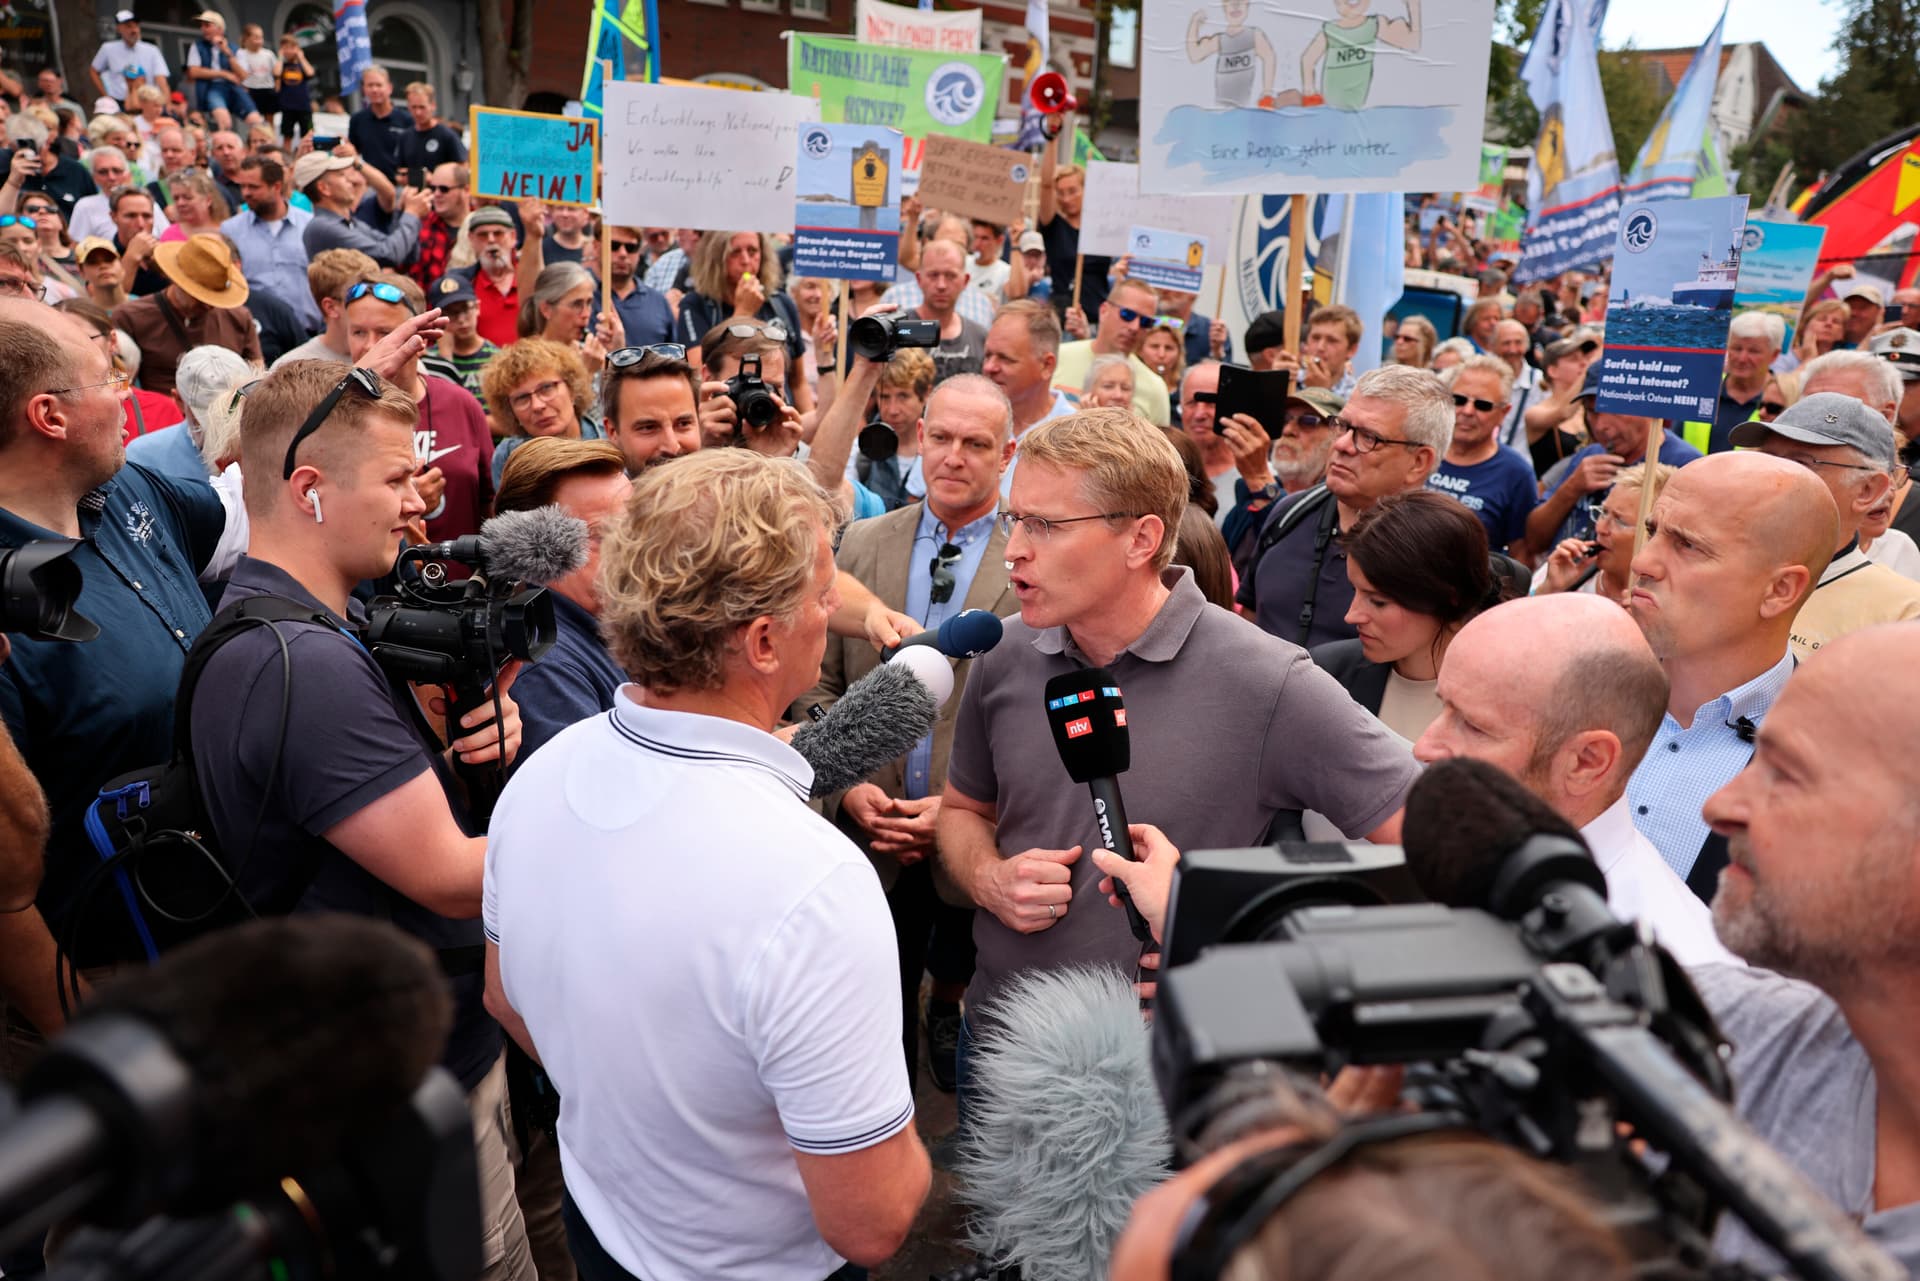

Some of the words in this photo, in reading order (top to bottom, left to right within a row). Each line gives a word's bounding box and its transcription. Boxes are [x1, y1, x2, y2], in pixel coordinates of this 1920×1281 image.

[1225, 56, 1250, 68] NPO
[1337, 47, 1366, 63] NPO
[801, 41, 912, 87] NATIONALPARK
[567, 121, 593, 152] JA
[1604, 358, 1636, 371] Surfen
[1638, 360, 1662, 373] bald
[1662, 364, 1682, 374] nur
[1602, 373, 1625, 384] noch
[1626, 373, 1639, 385] im
[1640, 375, 1689, 389] Internet?
[1600, 388, 1645, 402] Nationalpark
[1647, 392, 1673, 404] Ostsee
[1673, 394, 1698, 406] NEIN
[1429, 473, 1470, 492] GANZ
[1069, 721, 1087, 735] ntv
